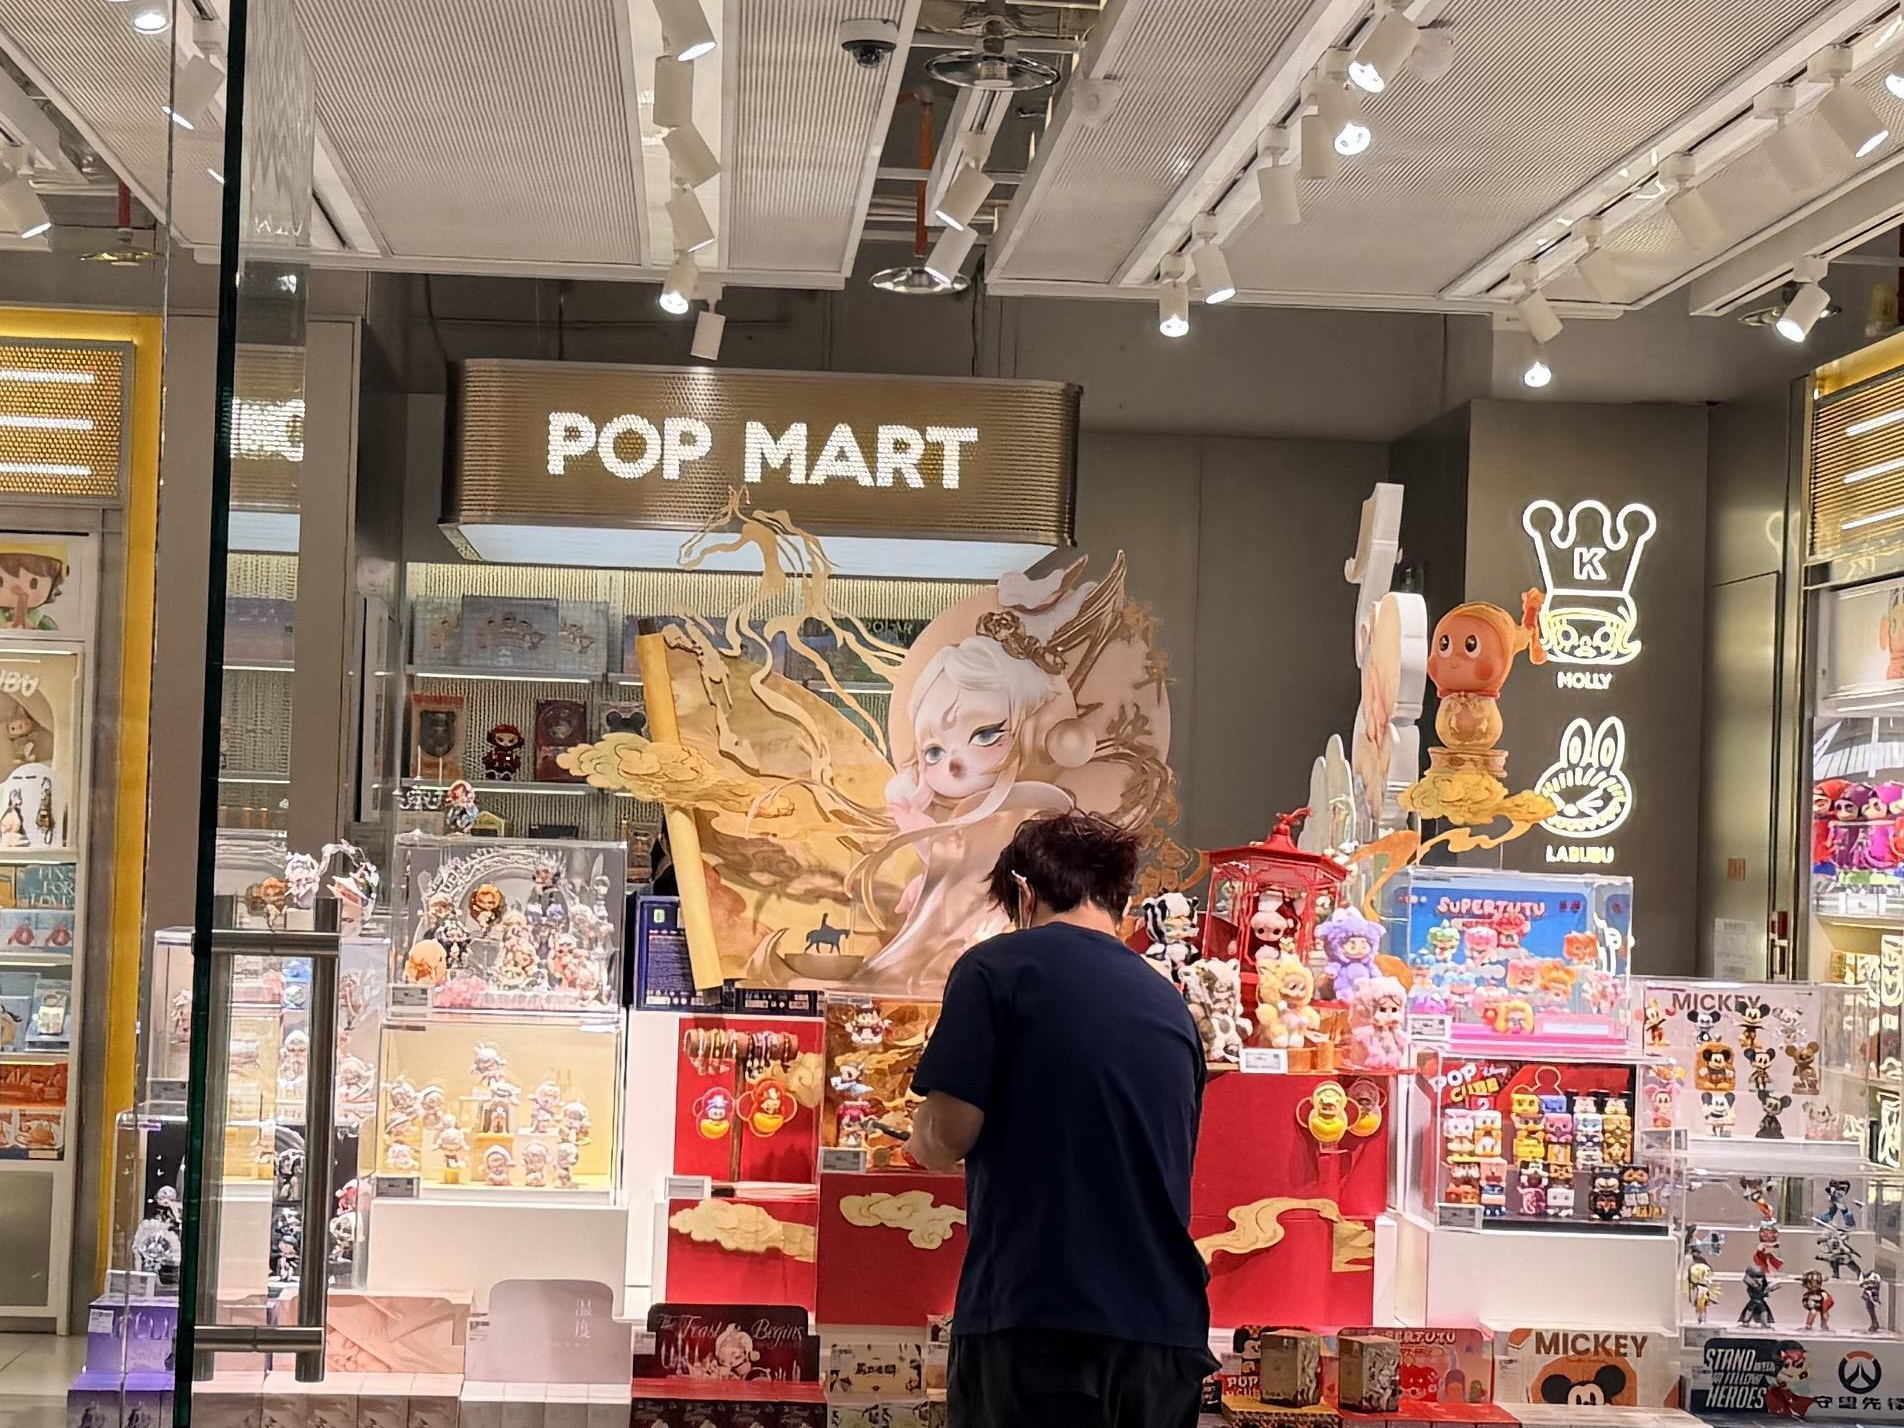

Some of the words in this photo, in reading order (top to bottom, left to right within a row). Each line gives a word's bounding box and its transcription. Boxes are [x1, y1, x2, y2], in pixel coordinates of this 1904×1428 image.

[547, 411, 713, 481] POP
[743, 421, 980, 490] MART
[1556, 671, 1613, 690] MOLLY
[1671, 992, 1762, 1013] MICKEY
[1534, 1330, 1649, 1359] MICKEY
[1703, 1348, 1757, 1372] STAND
[1705, 1385, 1768, 1409] HEROES
